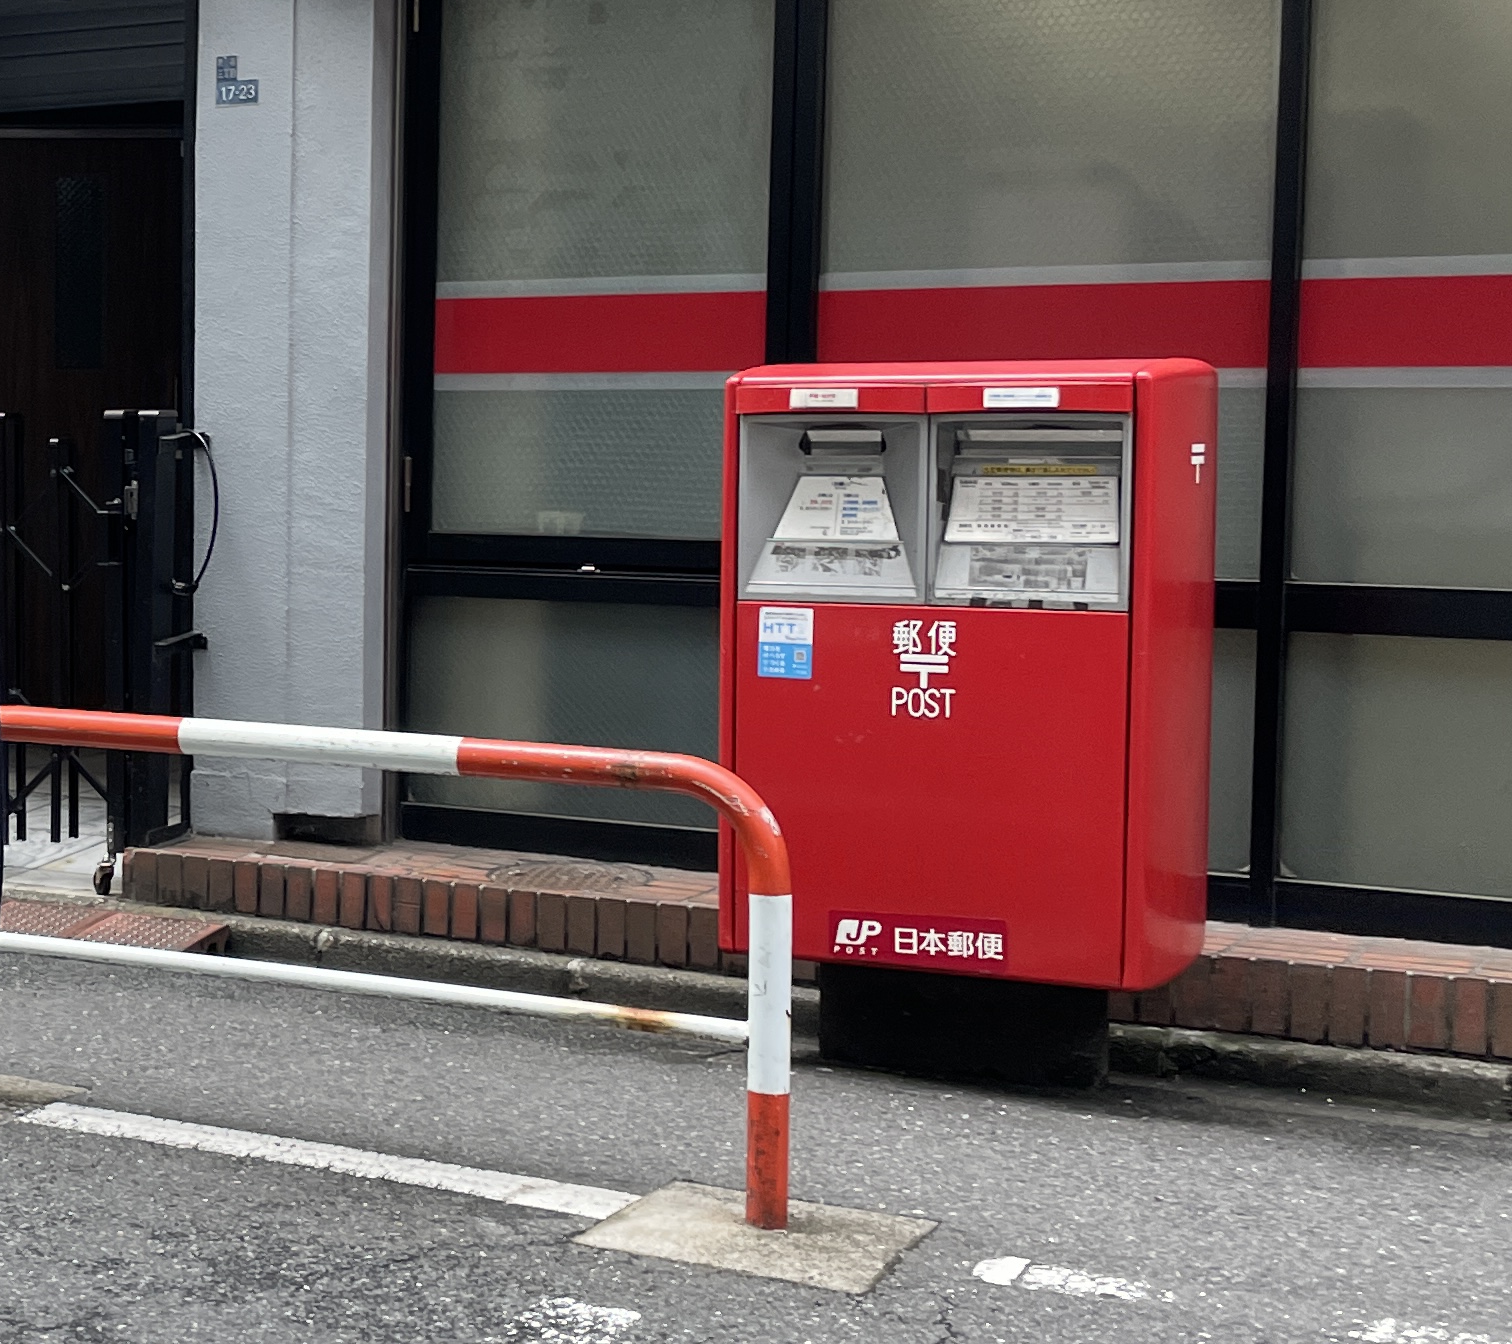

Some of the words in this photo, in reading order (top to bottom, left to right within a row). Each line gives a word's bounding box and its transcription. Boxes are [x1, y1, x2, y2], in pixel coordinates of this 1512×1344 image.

[221, 84, 256, 101] 17-23
[892, 619, 957, 657] 郵便
[891, 686, 956, 719] POST
[833, 945, 879, 956] POST
[894, 926, 1004, 961] 日本郵便
